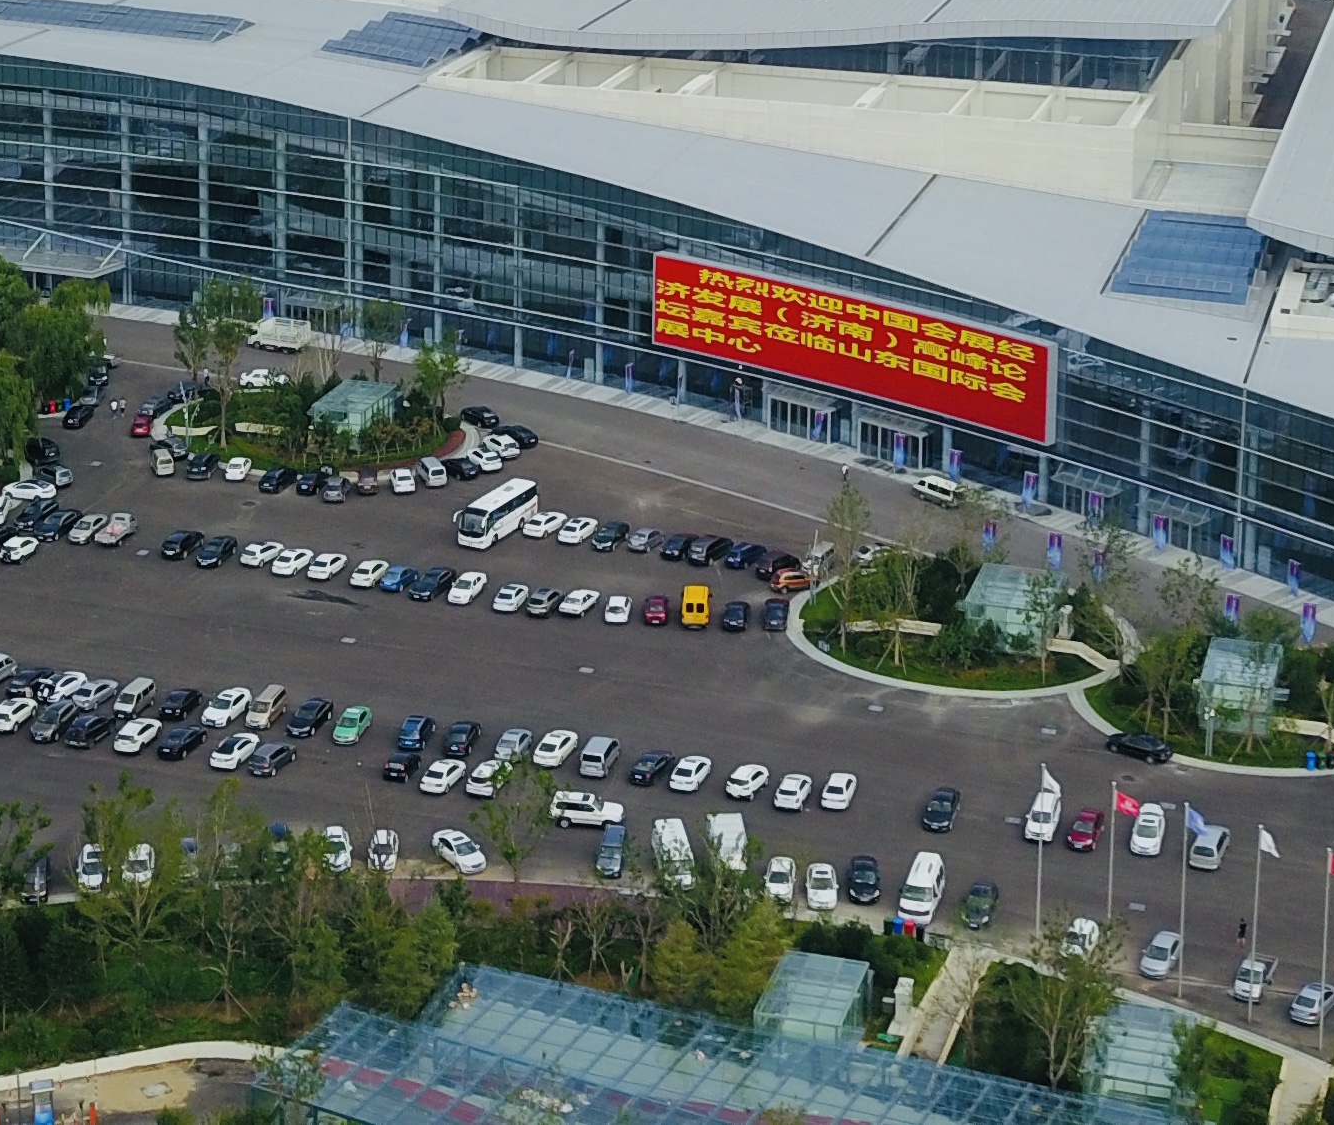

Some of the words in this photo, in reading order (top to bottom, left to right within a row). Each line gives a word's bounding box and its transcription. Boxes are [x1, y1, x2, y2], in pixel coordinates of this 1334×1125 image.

[655, 318, 763, 354] 展中心
[655, 299, 1027, 404] 坛嘉宾莅临山东国际会
[698, 268, 1037, 364] 热烈欢迎中国会展经
